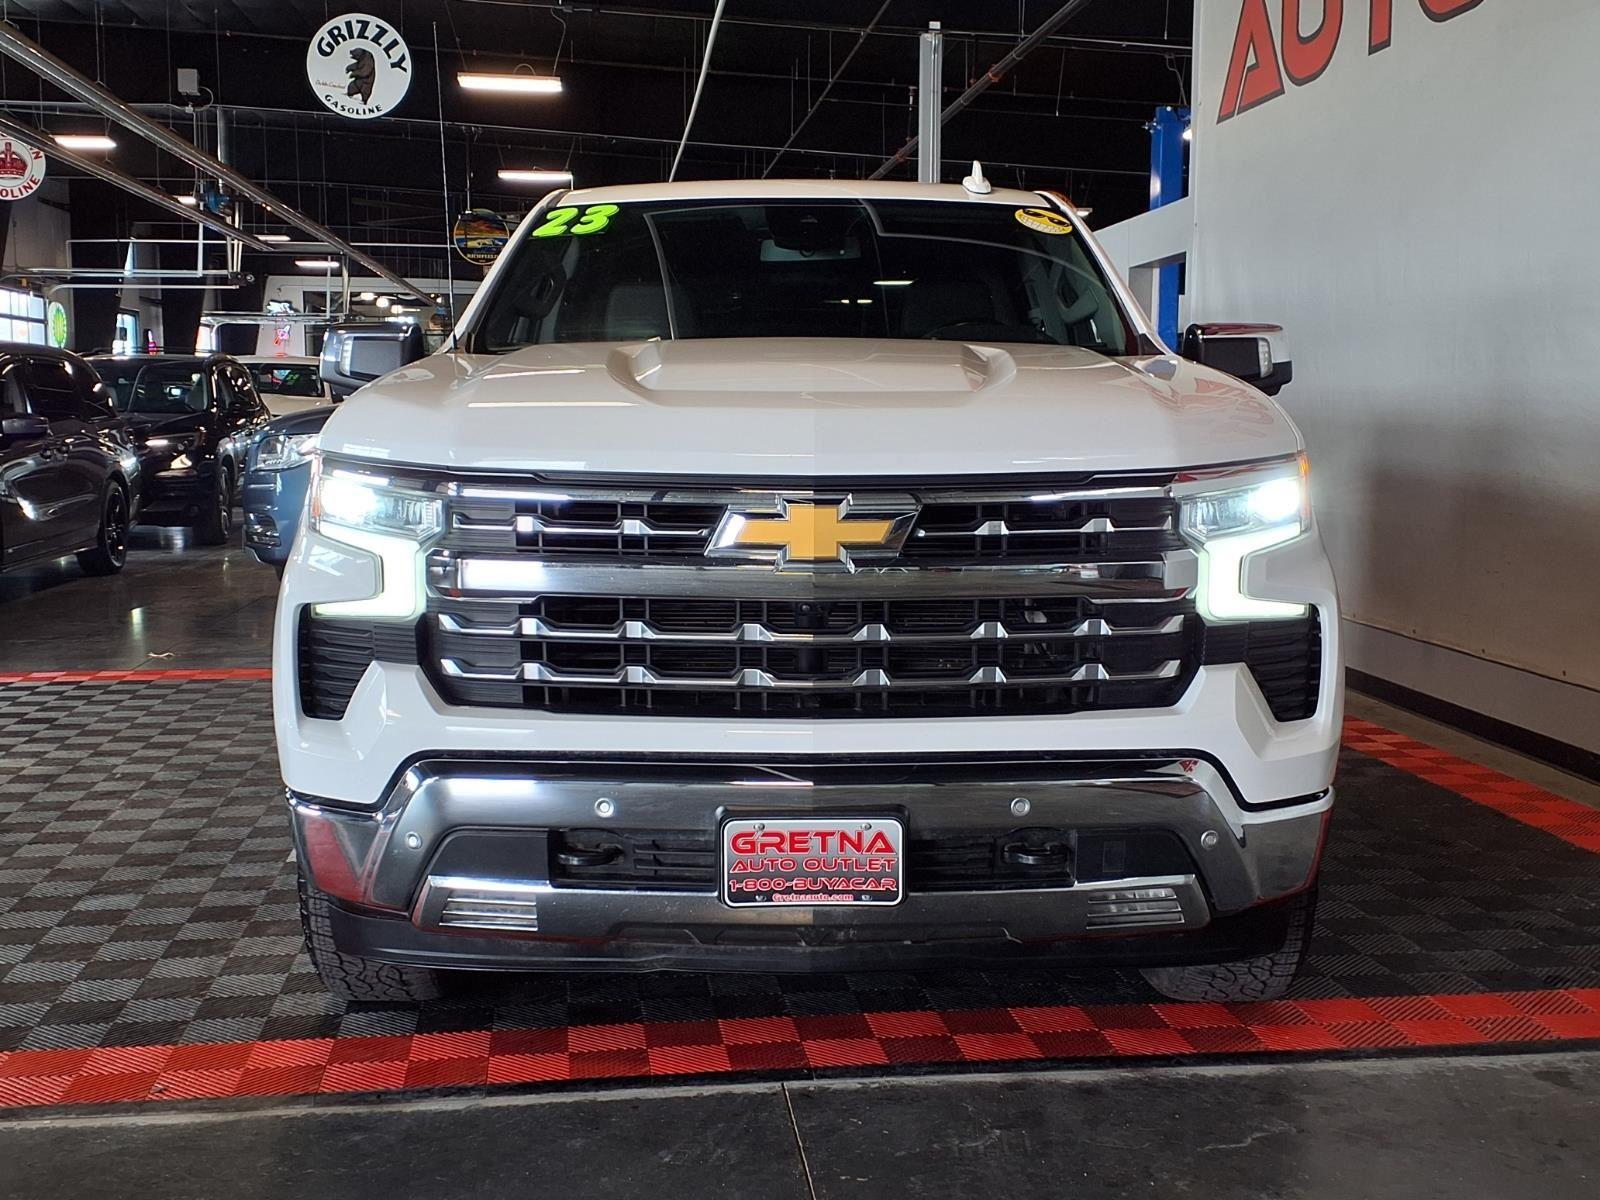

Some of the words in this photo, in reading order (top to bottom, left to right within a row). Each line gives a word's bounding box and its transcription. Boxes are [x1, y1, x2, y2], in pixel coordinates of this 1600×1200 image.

[316, 19, 408, 73] GRIZZLY
[324, 94, 383, 116] GASOLINE
[532, 204, 620, 237] 23
[730, 829, 897, 855] GRETNA
[729, 857, 797, 873] AUTO
[802, 857, 898, 872] OUTLET
[729, 877, 898, 892] 1-800-BUYACAR
